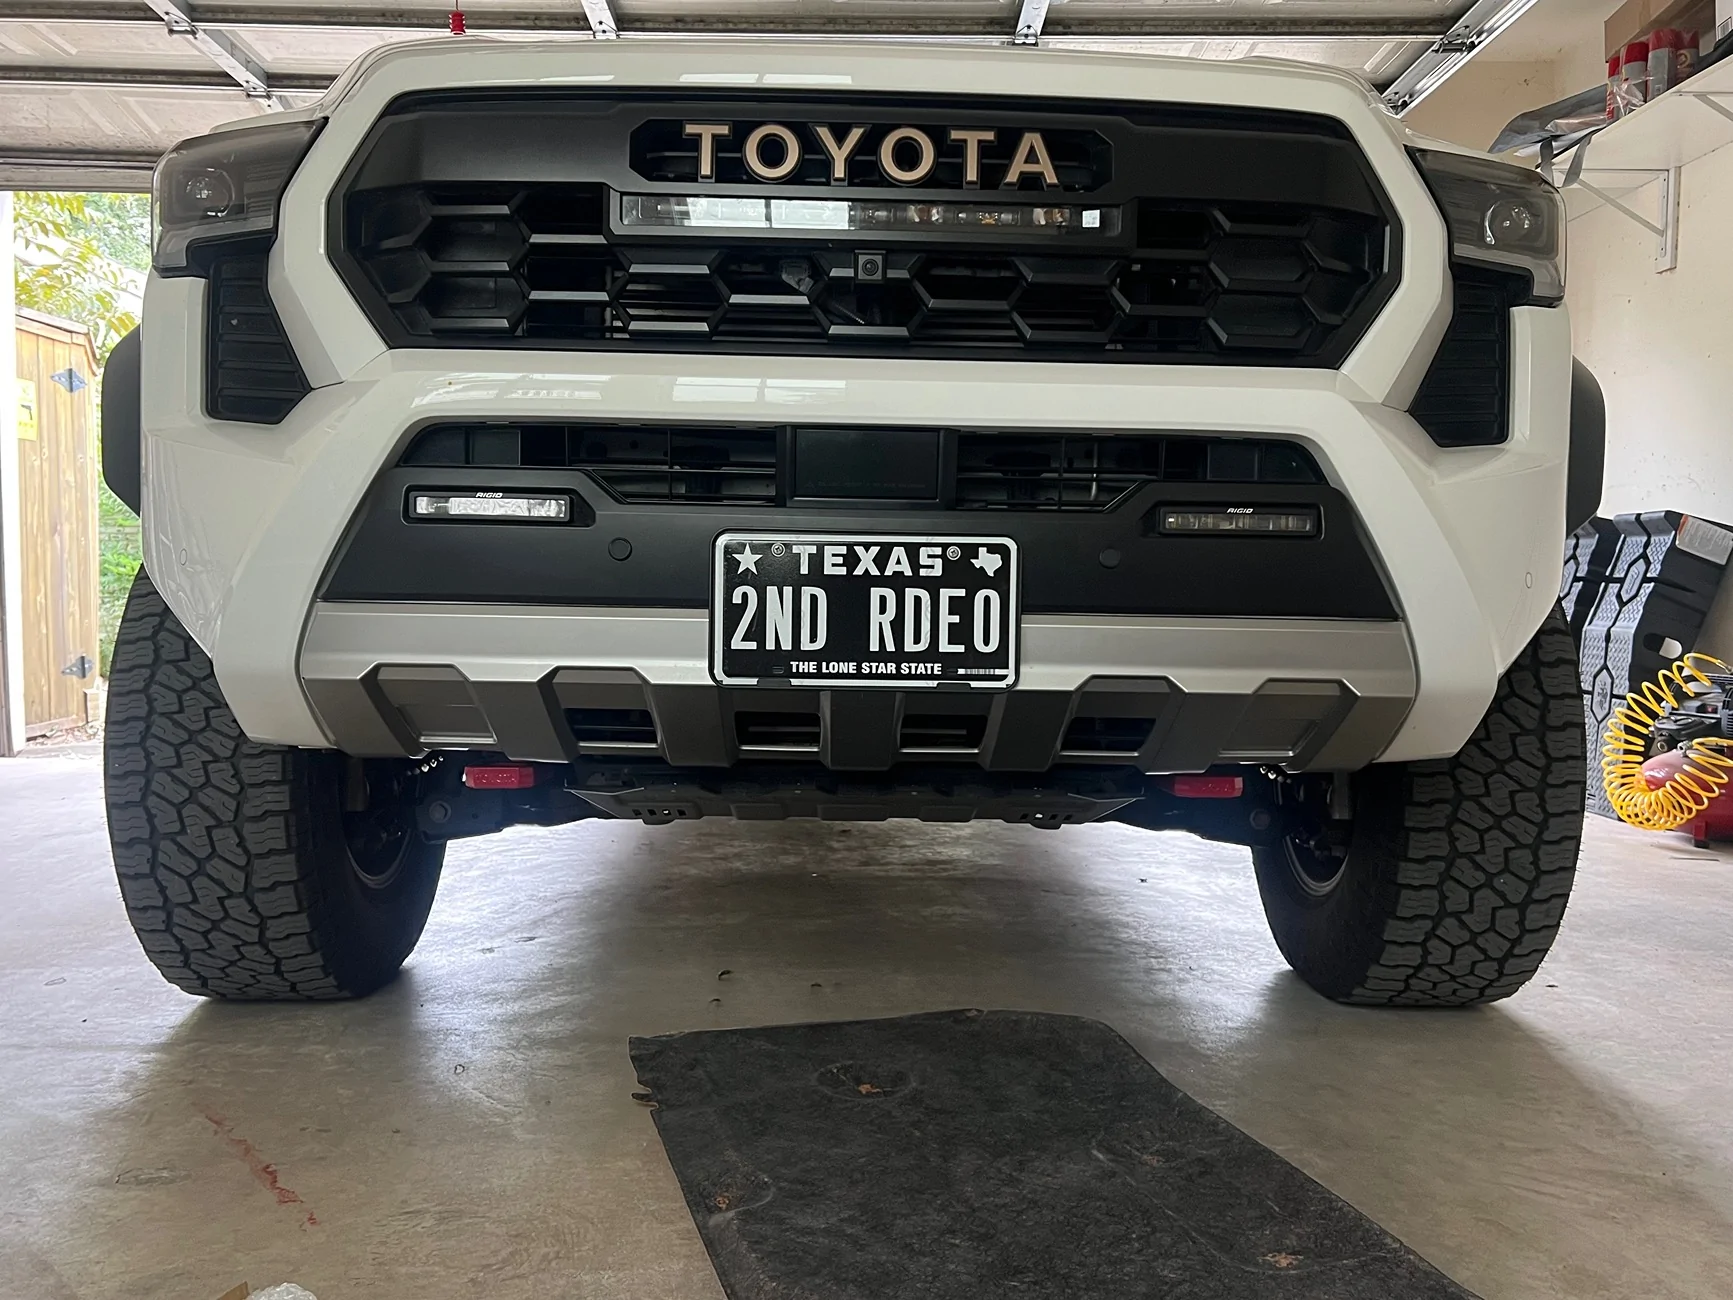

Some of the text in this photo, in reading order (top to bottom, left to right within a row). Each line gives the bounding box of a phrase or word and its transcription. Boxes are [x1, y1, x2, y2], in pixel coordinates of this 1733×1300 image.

[683, 122, 1060, 187] TOYOTA
[475, 491, 504, 499] RIGID
[792, 544, 943, 577] TEXAS
[730, 585, 828, 651] 2ND
[789, 660, 942, 676] THE LONE STAR STATE
